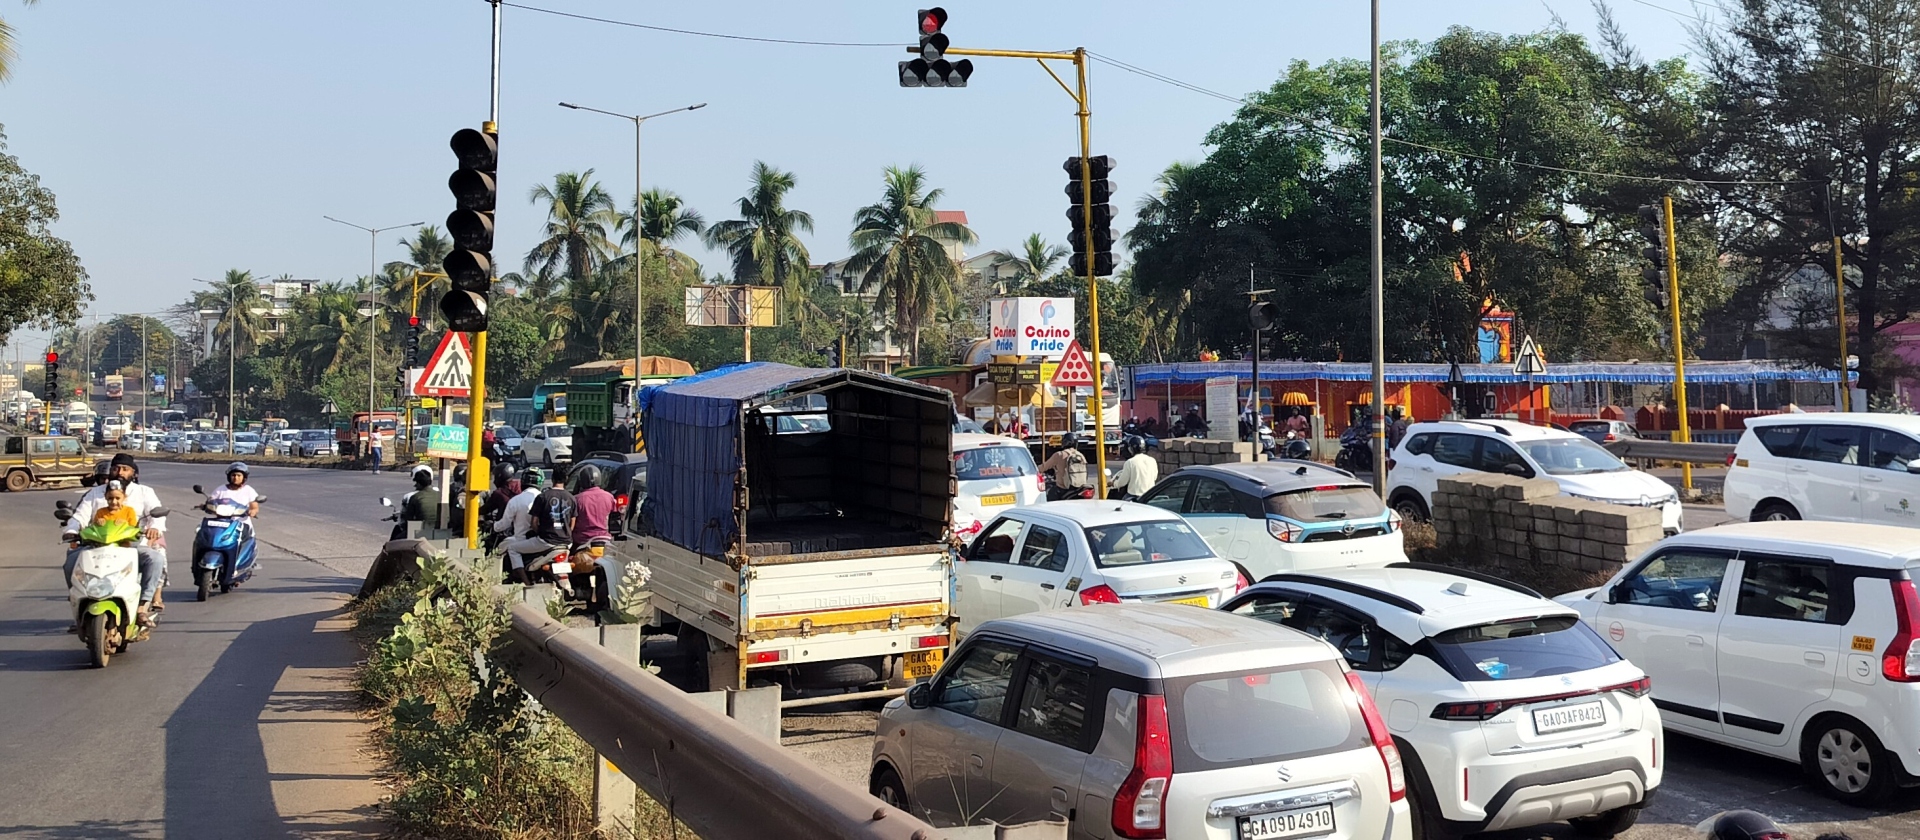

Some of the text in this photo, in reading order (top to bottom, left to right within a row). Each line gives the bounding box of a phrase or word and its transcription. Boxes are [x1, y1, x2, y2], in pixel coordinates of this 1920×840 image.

[993, 325, 1017, 338] Casino
[1024, 325, 1071, 338] Casino
[995, 338, 1014, 351] Pride
[1030, 338, 1065, 351] Pride
[998, 366, 1015, 374] TRAFFIC
[994, 375, 1010, 383] POLICE
[433, 426, 465, 442] AXIS
[1542, 706, 1603, 727] GA03AF8423
